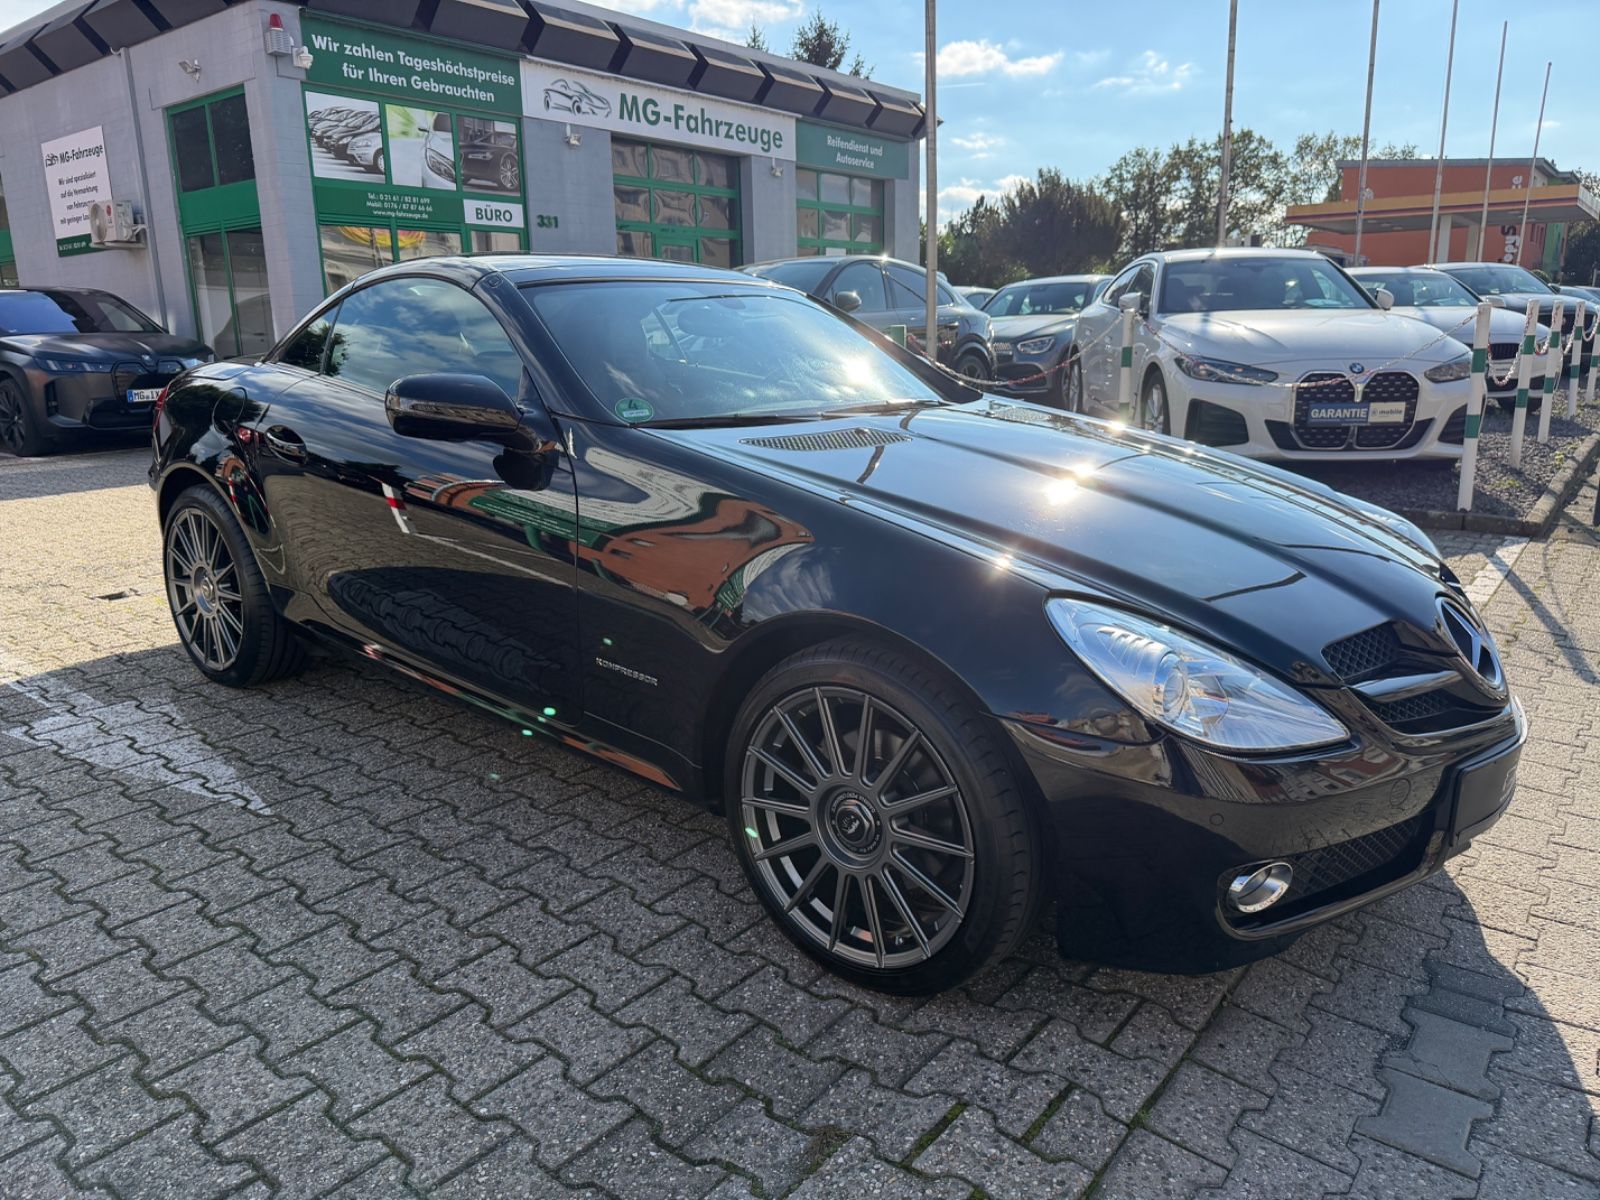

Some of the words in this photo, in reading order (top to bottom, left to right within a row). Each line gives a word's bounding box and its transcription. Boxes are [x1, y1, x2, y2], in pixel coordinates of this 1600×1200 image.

[311, 34, 340, 53] Wir
[343, 43, 394, 63] zahlen
[397, 51, 516, 86] Tageshöchstpreise
[342, 62, 364, 80] für
[368, 67, 407, 87] Ihren
[411, 75, 495, 102] Gebrauchten
[619, 93, 783, 152] MG-Fahrzeuge
[59, 145, 103, 164] MG-Fahrzeuge
[827, 134, 868, 156] Reifendienst
[869, 144, 883, 157] und
[836, 152, 875, 169] Autoservice
[475, 203, 513, 222] BÜRO
[537, 214, 559, 228] 331
[1310, 407, 1369, 418] GARANTIE
